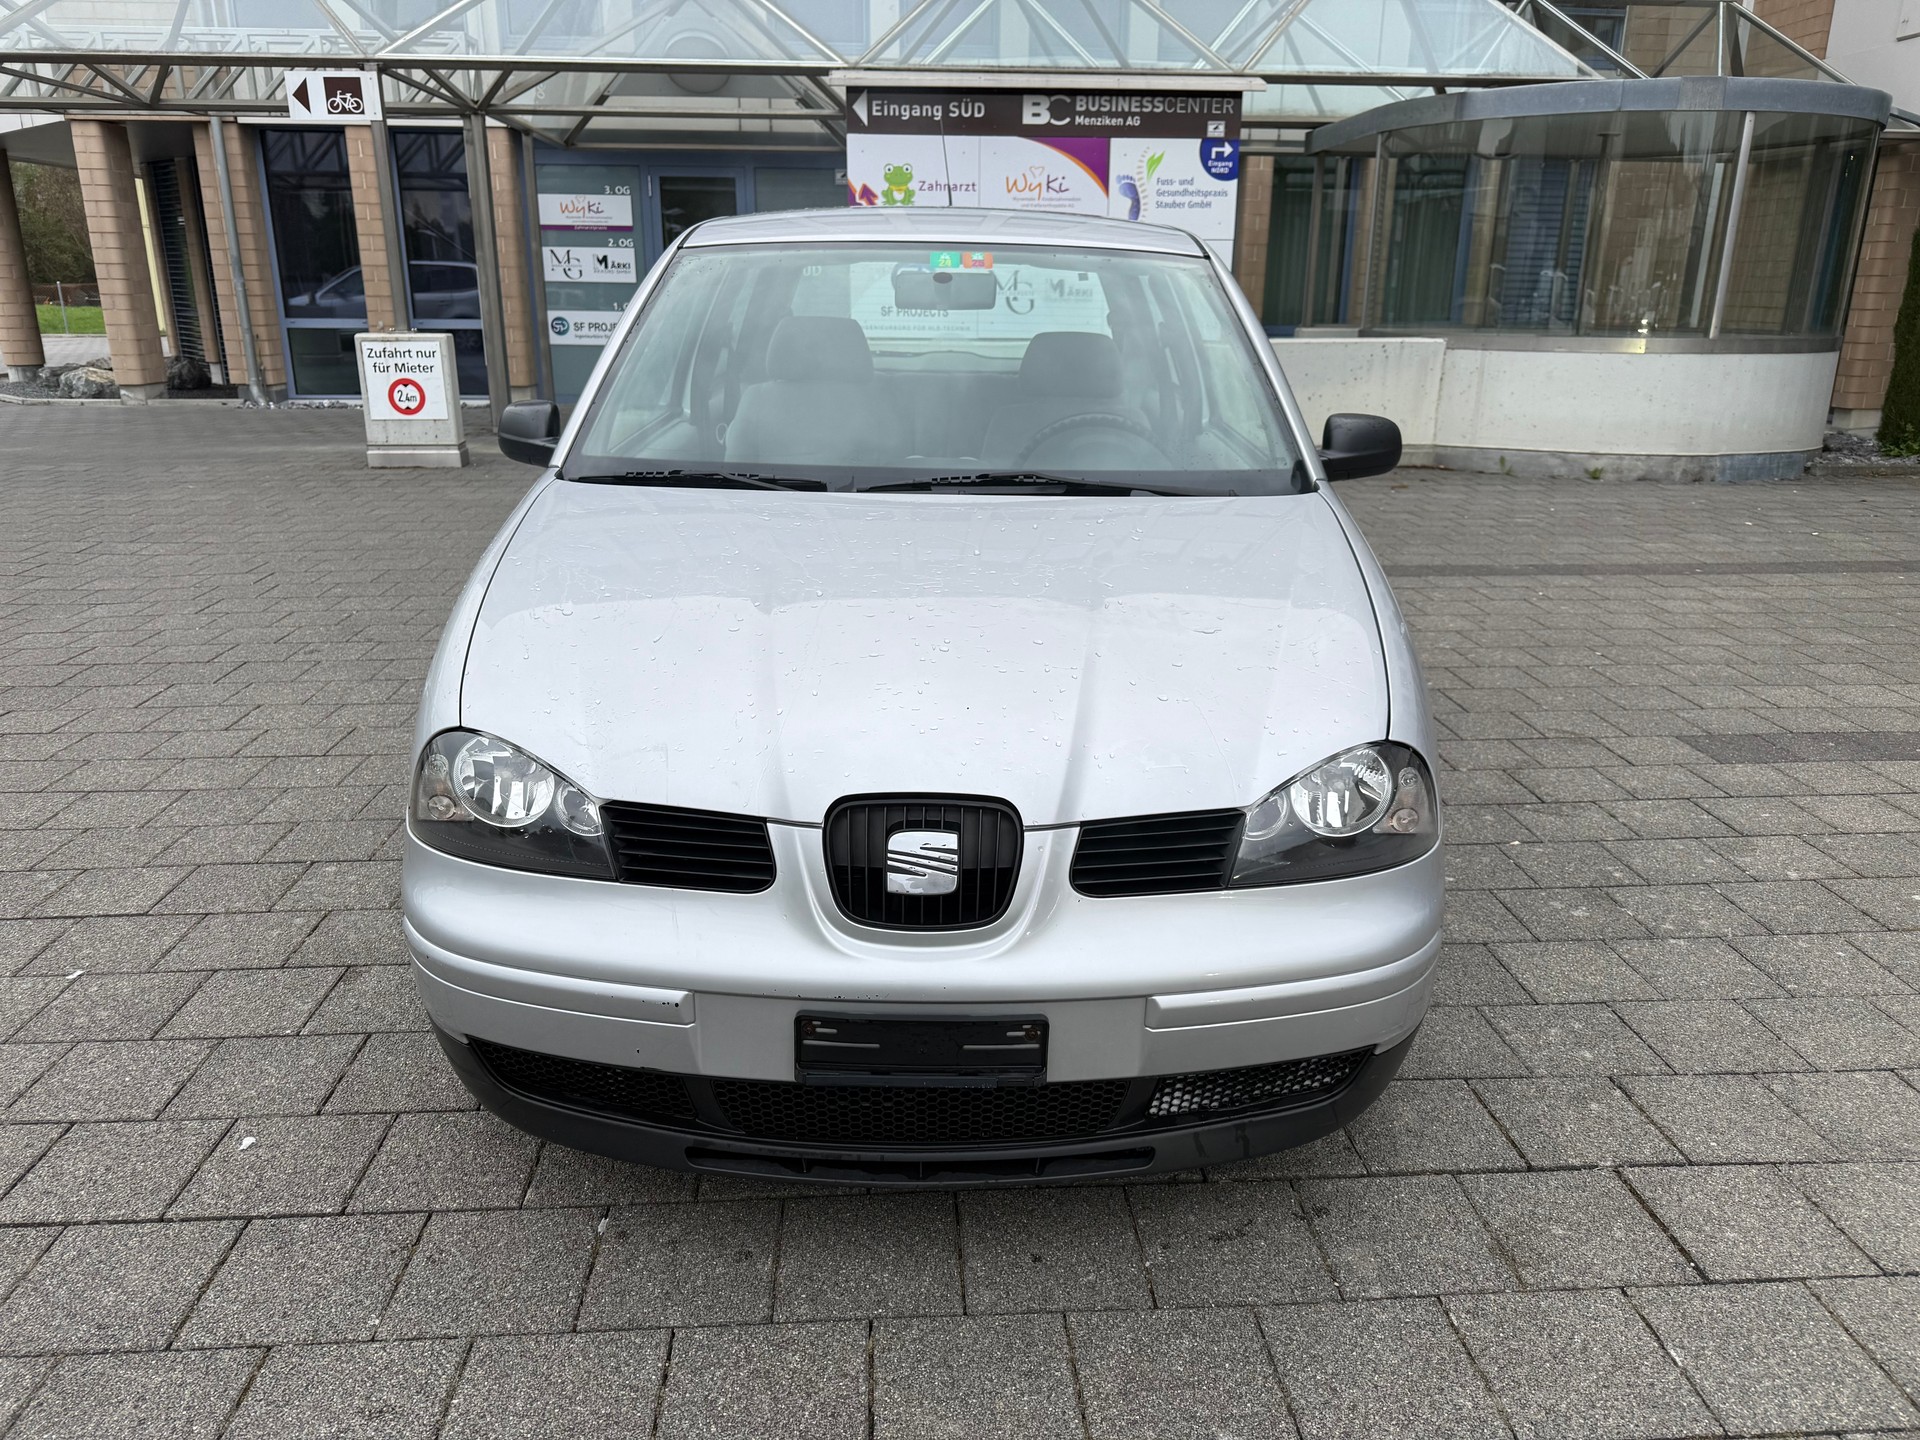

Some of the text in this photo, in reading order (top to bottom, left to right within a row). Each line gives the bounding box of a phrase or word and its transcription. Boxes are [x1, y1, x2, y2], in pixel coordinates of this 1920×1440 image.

[872, 98, 986, 121] Eingang SÜD
[1075, 95, 1235, 115] BUSINESSCENTER
[1075, 115, 1141, 127] Menziken AG
[1207, 160, 1234, 168] Eingang
[917, 180, 978, 193] Zahnarzt
[1156, 177, 1194, 187] Fuss- und
[604, 185, 631, 195] 3. OG
[1155, 188, 1229, 199] Gesundheitspraxis
[1155, 200, 1213, 210] Stauber GmbH
[607, 238, 634, 248] 2. OG
[880, 306, 894, 318] SF
[573, 322, 586, 332] SF
[366, 346, 437, 359] Zufahrt nur
[372, 361, 434, 374] für Mieter
